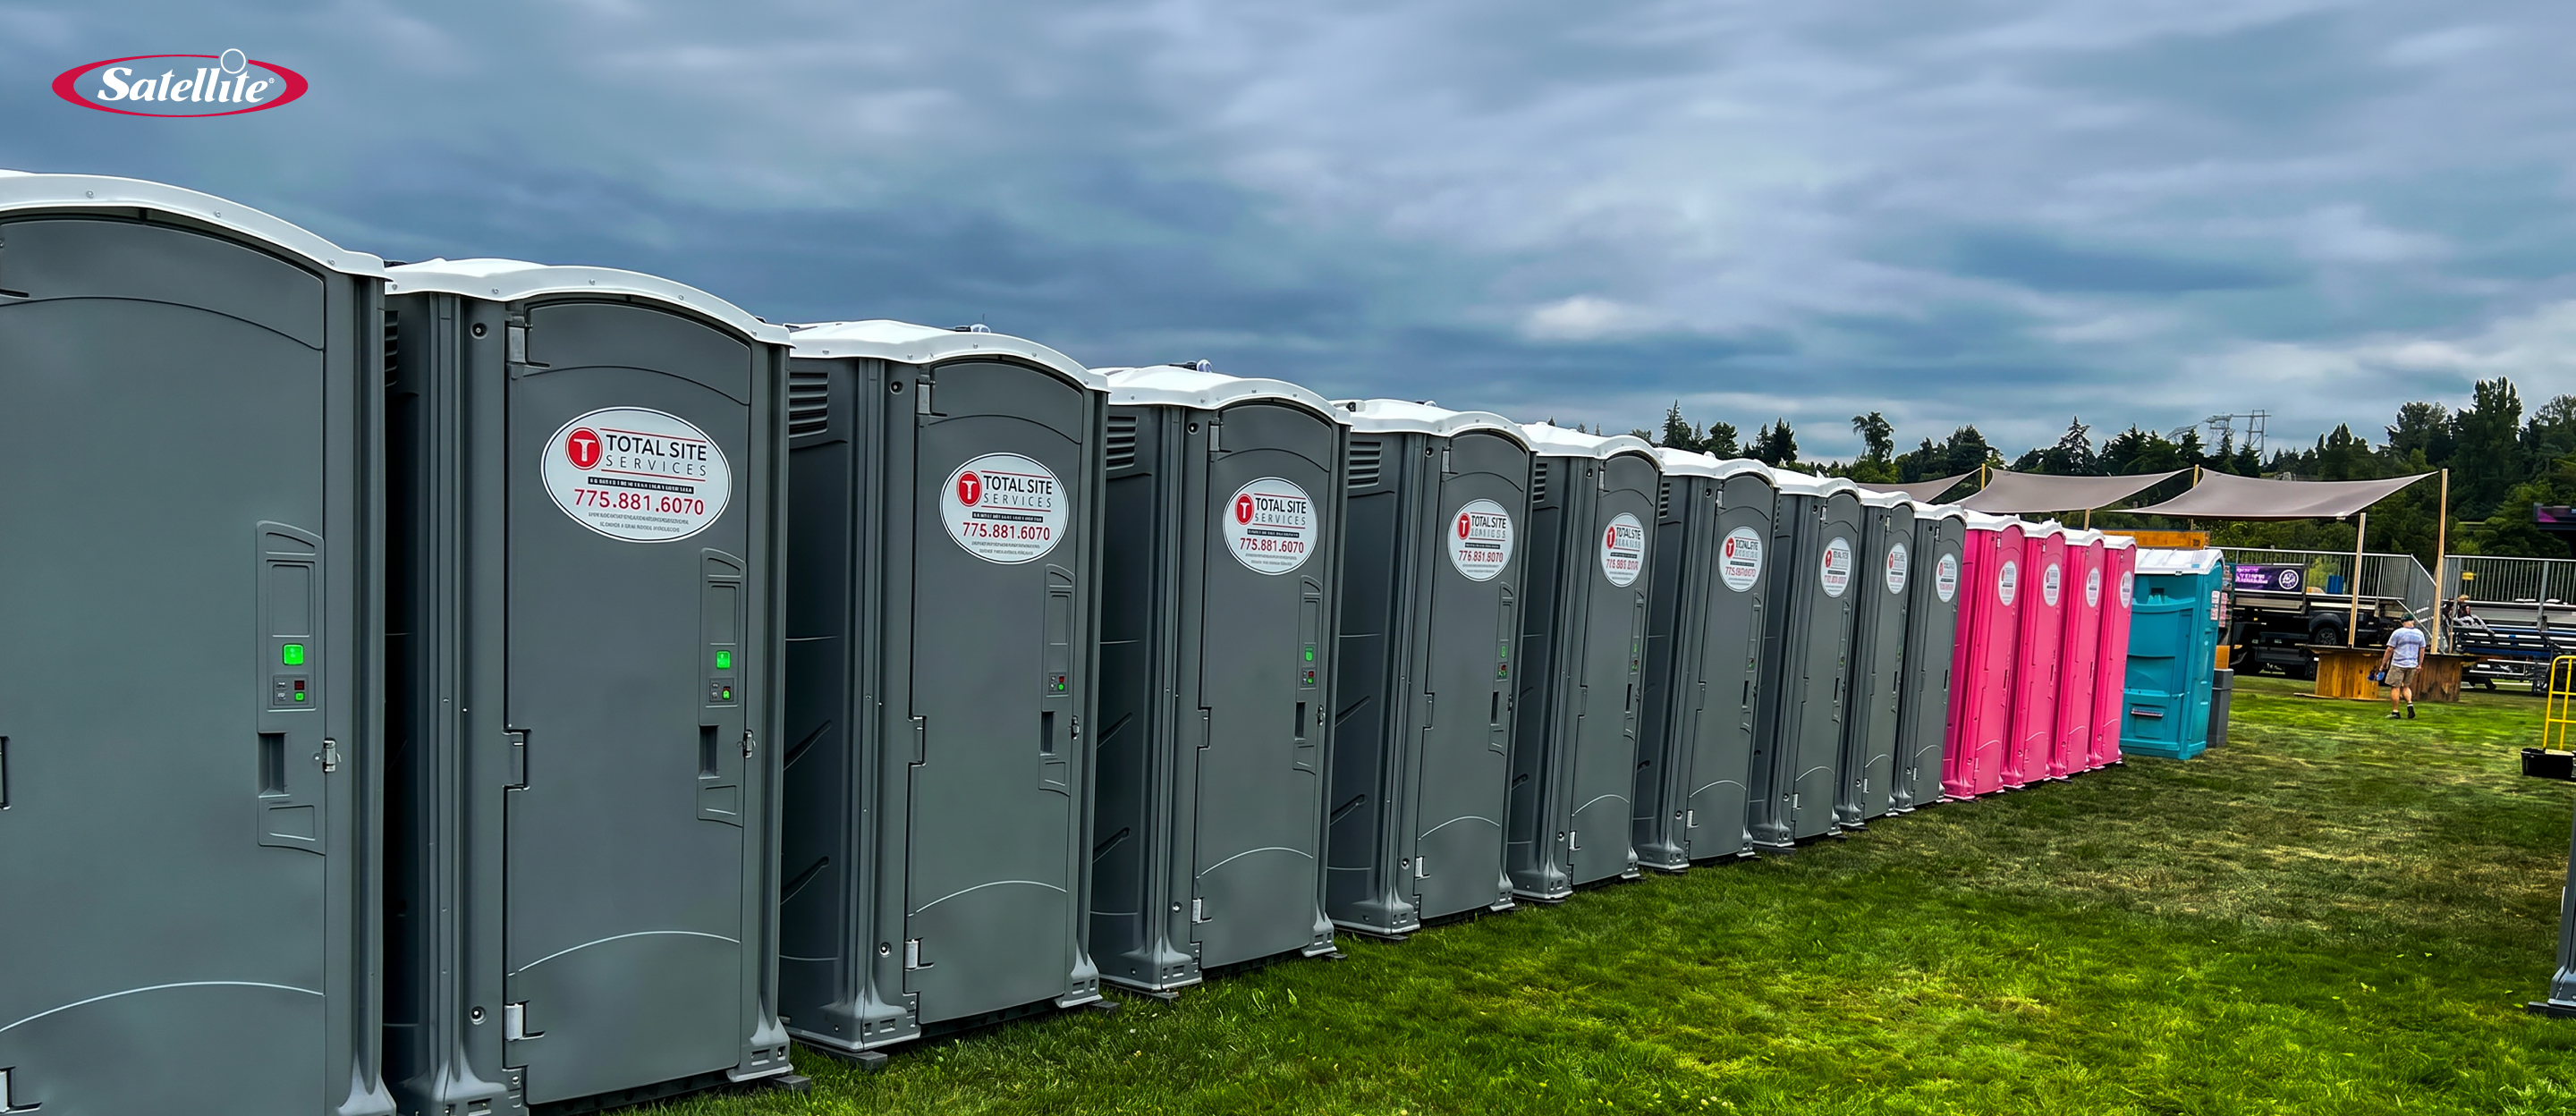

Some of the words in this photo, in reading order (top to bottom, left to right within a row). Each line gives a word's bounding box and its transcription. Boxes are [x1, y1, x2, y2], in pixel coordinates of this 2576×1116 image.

[606, 434, 665, 457] TOTAL
[669, 442, 708, 461] SITE
[606, 454, 707, 477] SERVICES
[983, 475, 1025, 493] TOTAL
[1027, 479, 1053, 495] SITE
[574, 488, 705, 516] 775.881.6070
[984, 493, 1052, 508] SERVICES
[1255, 497, 1285, 512] TOTAL
[1287, 500, 1307, 514] SITE
[1255, 513, 1306, 526] SERVICES
[1471, 515, 1491, 528] TOTAL
[1491, 516, 1507, 528] SITE
[962, 521, 1050, 541] 775.881.6070
[1240, 537, 1304, 554] 775.881.6070
